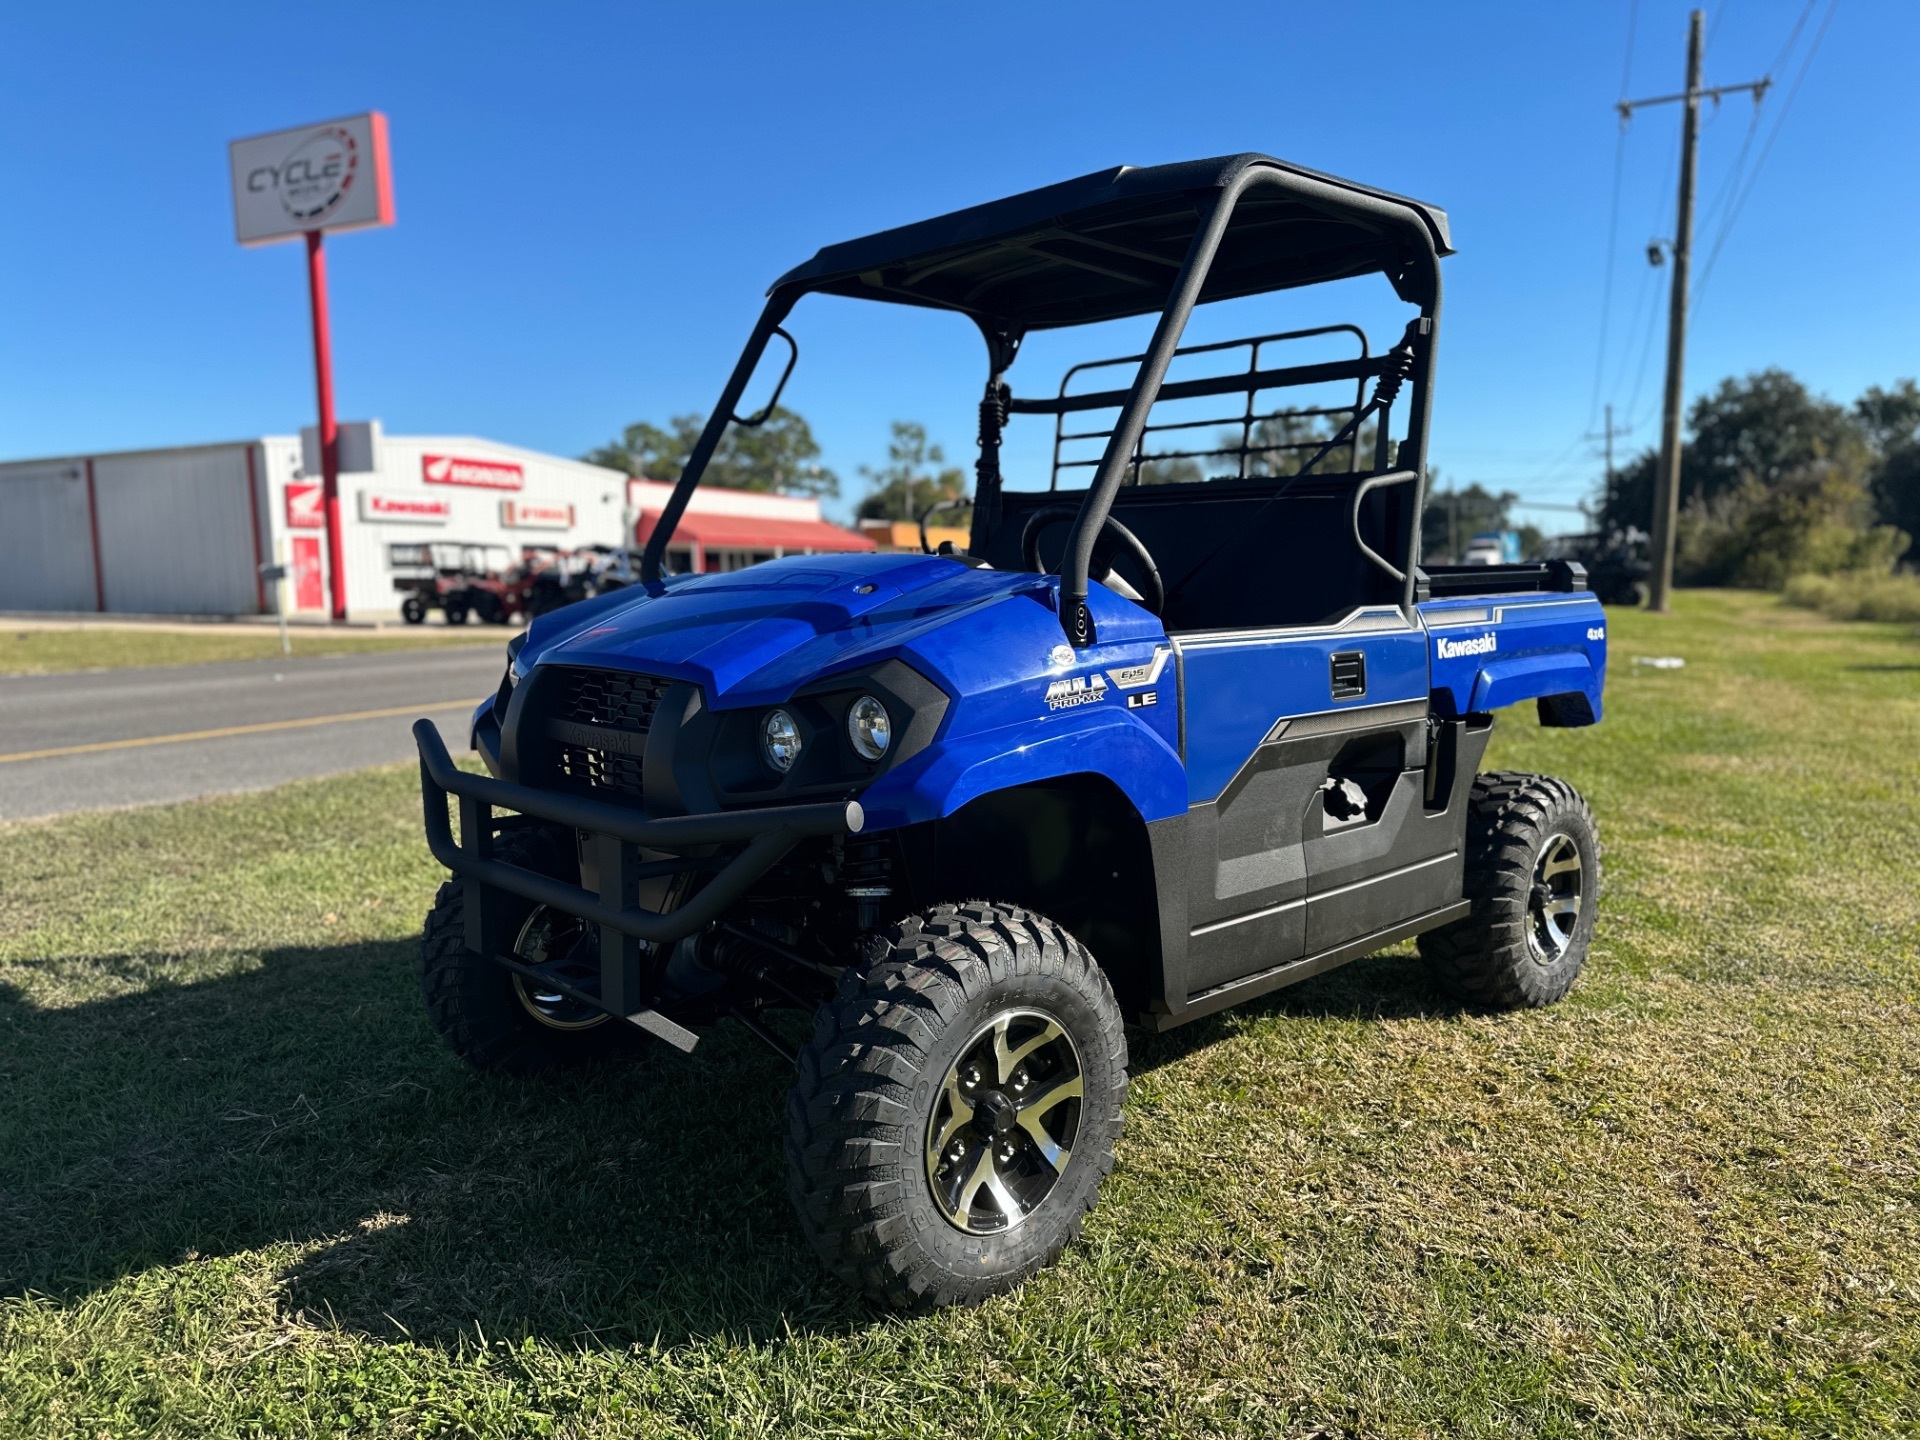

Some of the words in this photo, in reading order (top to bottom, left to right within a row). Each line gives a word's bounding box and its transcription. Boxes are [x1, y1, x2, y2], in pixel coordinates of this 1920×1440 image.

[247, 153, 342, 193] CYCLE
[1437, 632, 1496, 659] Kawasaki
[1587, 627, 1604, 640] 4x4
[1127, 692, 1157, 708] LE
[569, 725, 631, 753] Kawasaki
